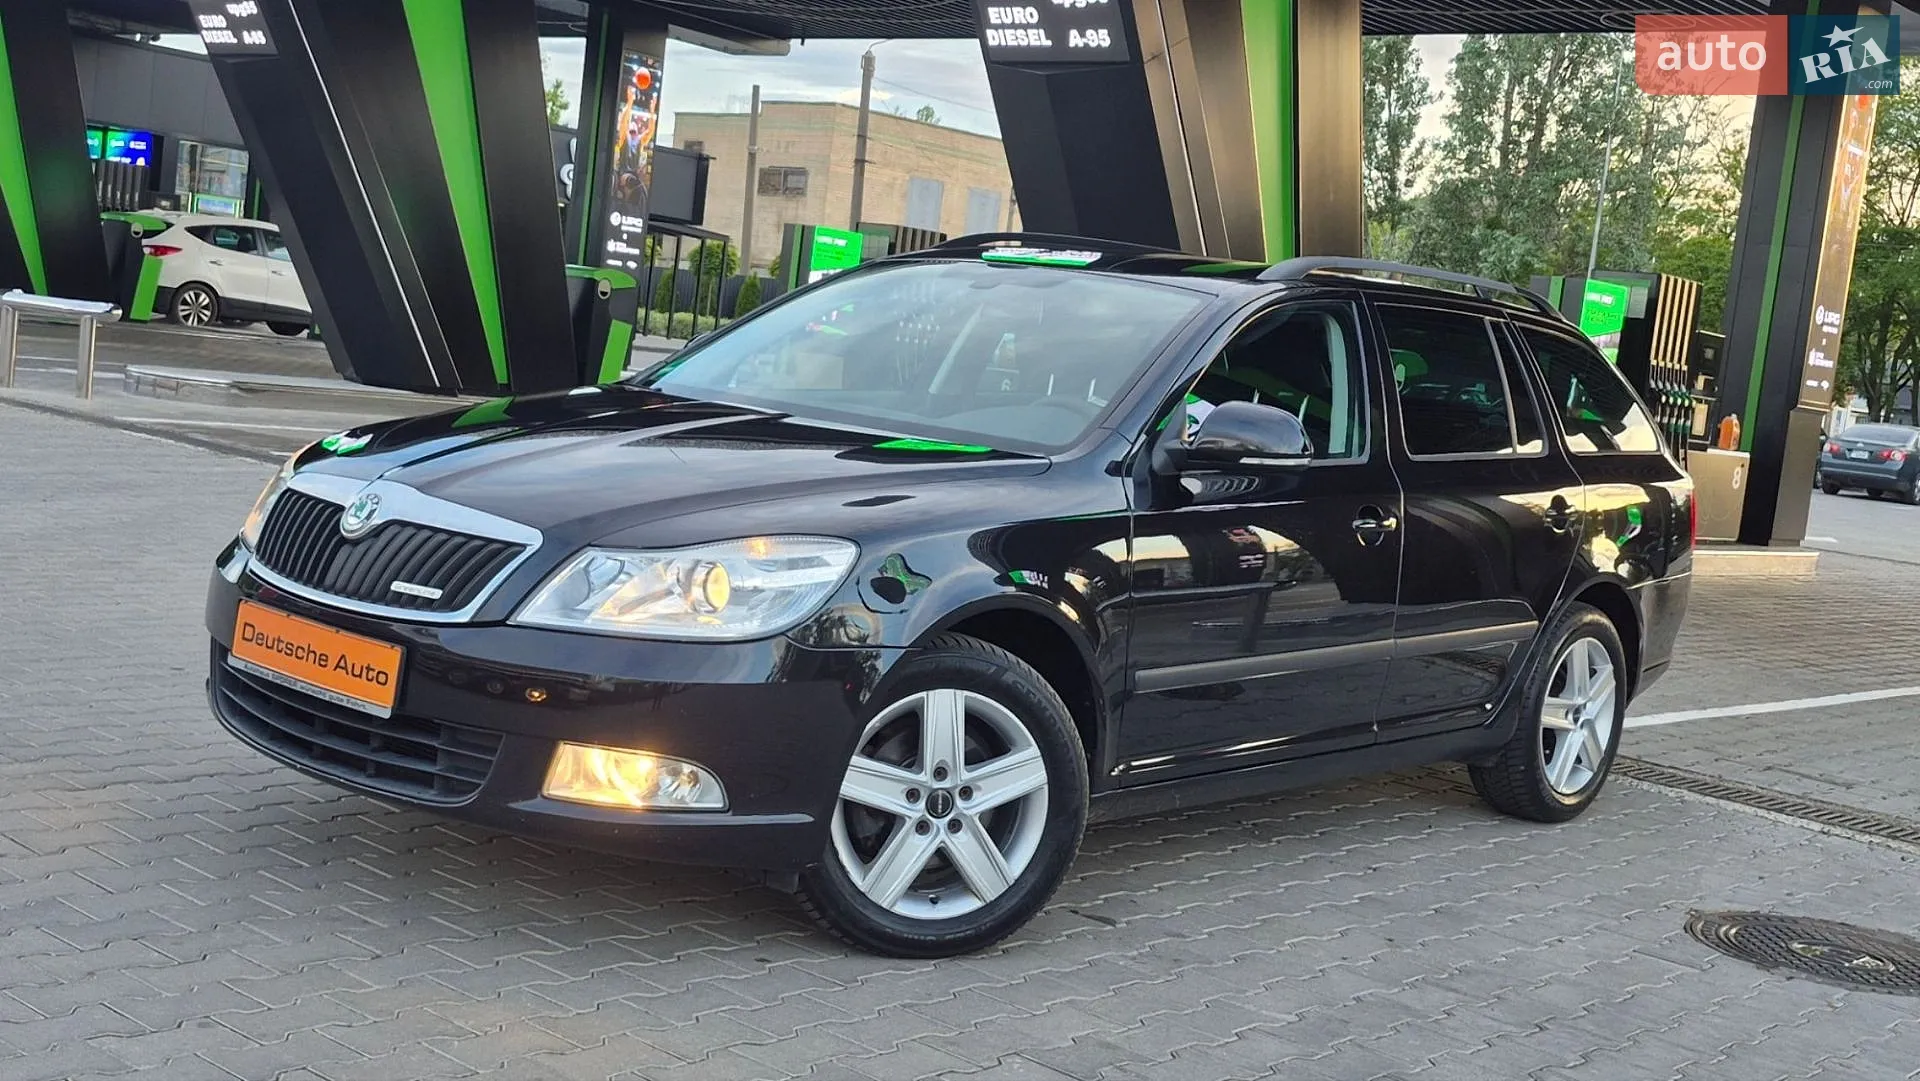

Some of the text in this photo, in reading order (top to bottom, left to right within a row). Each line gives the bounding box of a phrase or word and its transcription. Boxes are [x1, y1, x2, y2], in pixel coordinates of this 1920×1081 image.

[987, 6, 1039, 24] EURO
[985, 28, 1111, 48] DIESEL A-95
[1732, 466, 1741, 489] 8
[241, 621, 389, 686] Deutsche Auto
